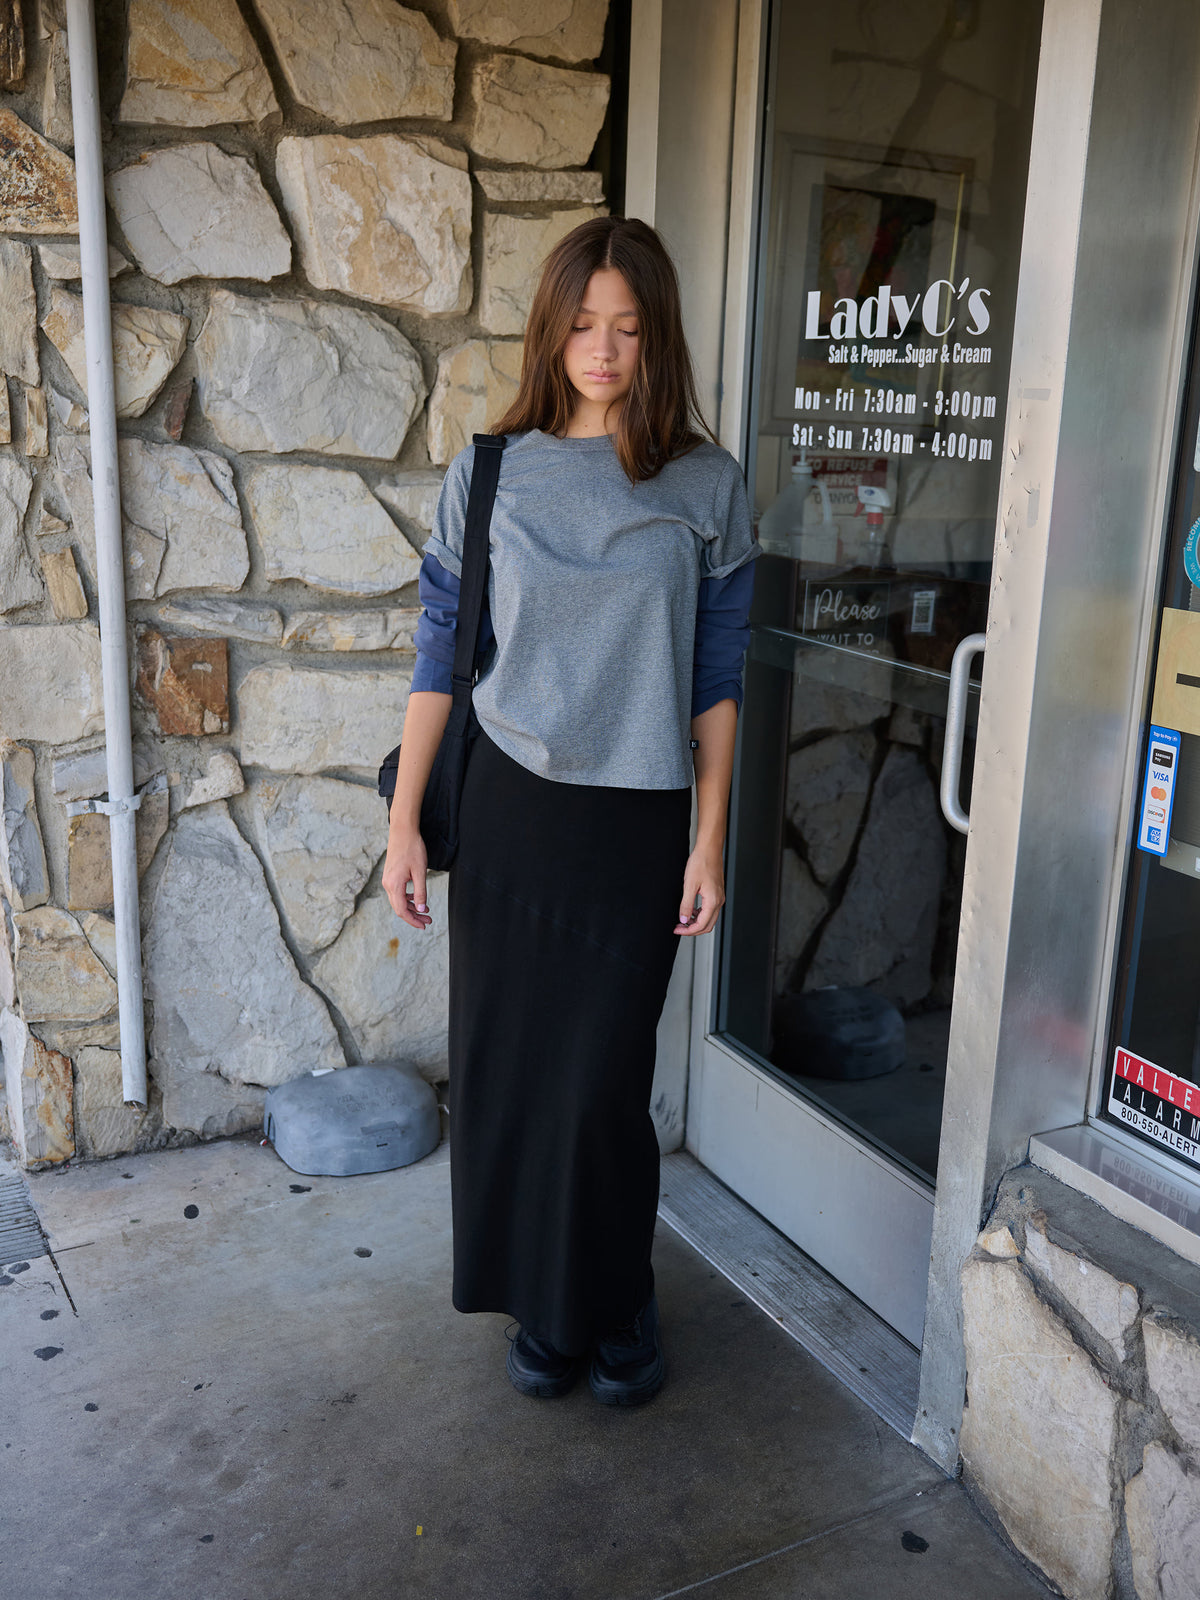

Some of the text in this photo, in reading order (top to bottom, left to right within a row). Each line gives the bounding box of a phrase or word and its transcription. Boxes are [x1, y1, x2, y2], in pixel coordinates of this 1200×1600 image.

[828, 344, 848, 364] Salt
[850, 345, 859, 363] &
[940, 343, 950, 363] &
[953, 342, 992, 364] Cream
[794, 387, 820, 410] Mon
[835, 388, 854, 412] Fri
[863, 388, 917, 414] 7:30am
[934, 390, 997, 420] 3:00pm
[792, 423, 814, 447] Sat
[828, 425, 853, 450] Sun
[862, 427, 914, 454] 7:30am
[931, 431, 993, 462] 4:00pm
[826, 458, 875, 472] REFUSE
[812, 588, 881, 630] Please
[817, 633, 874, 647] WAIT TO
[1152, 770, 1169, 783] VISA
[1123, 1056, 1193, 1110] VALLE
[1123, 1083, 1200, 1141] ALARM
